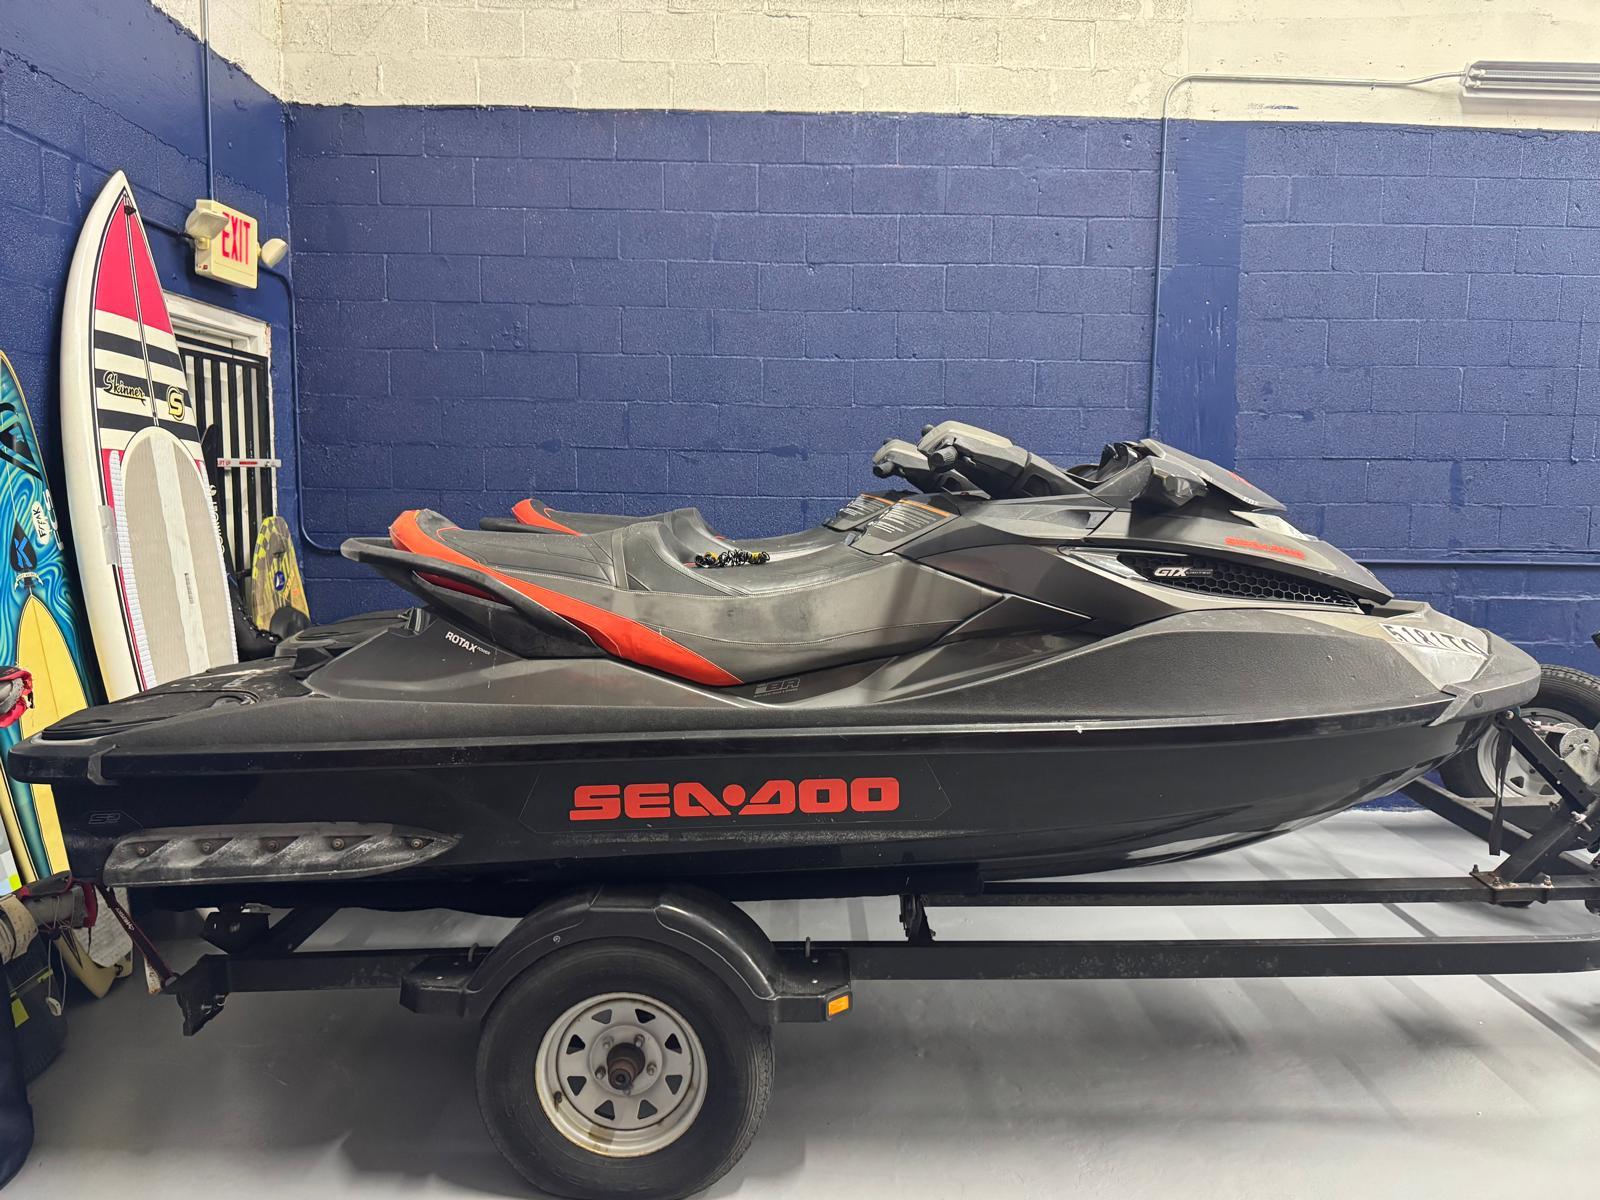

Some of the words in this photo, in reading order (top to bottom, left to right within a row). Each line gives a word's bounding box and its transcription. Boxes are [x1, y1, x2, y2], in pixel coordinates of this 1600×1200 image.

[222, 211, 250, 265] EXIT
[103, 370, 145, 402] Skinner
[1154, 566, 1191, 577] GTX
[445, 631, 477, 653] ROTAX
